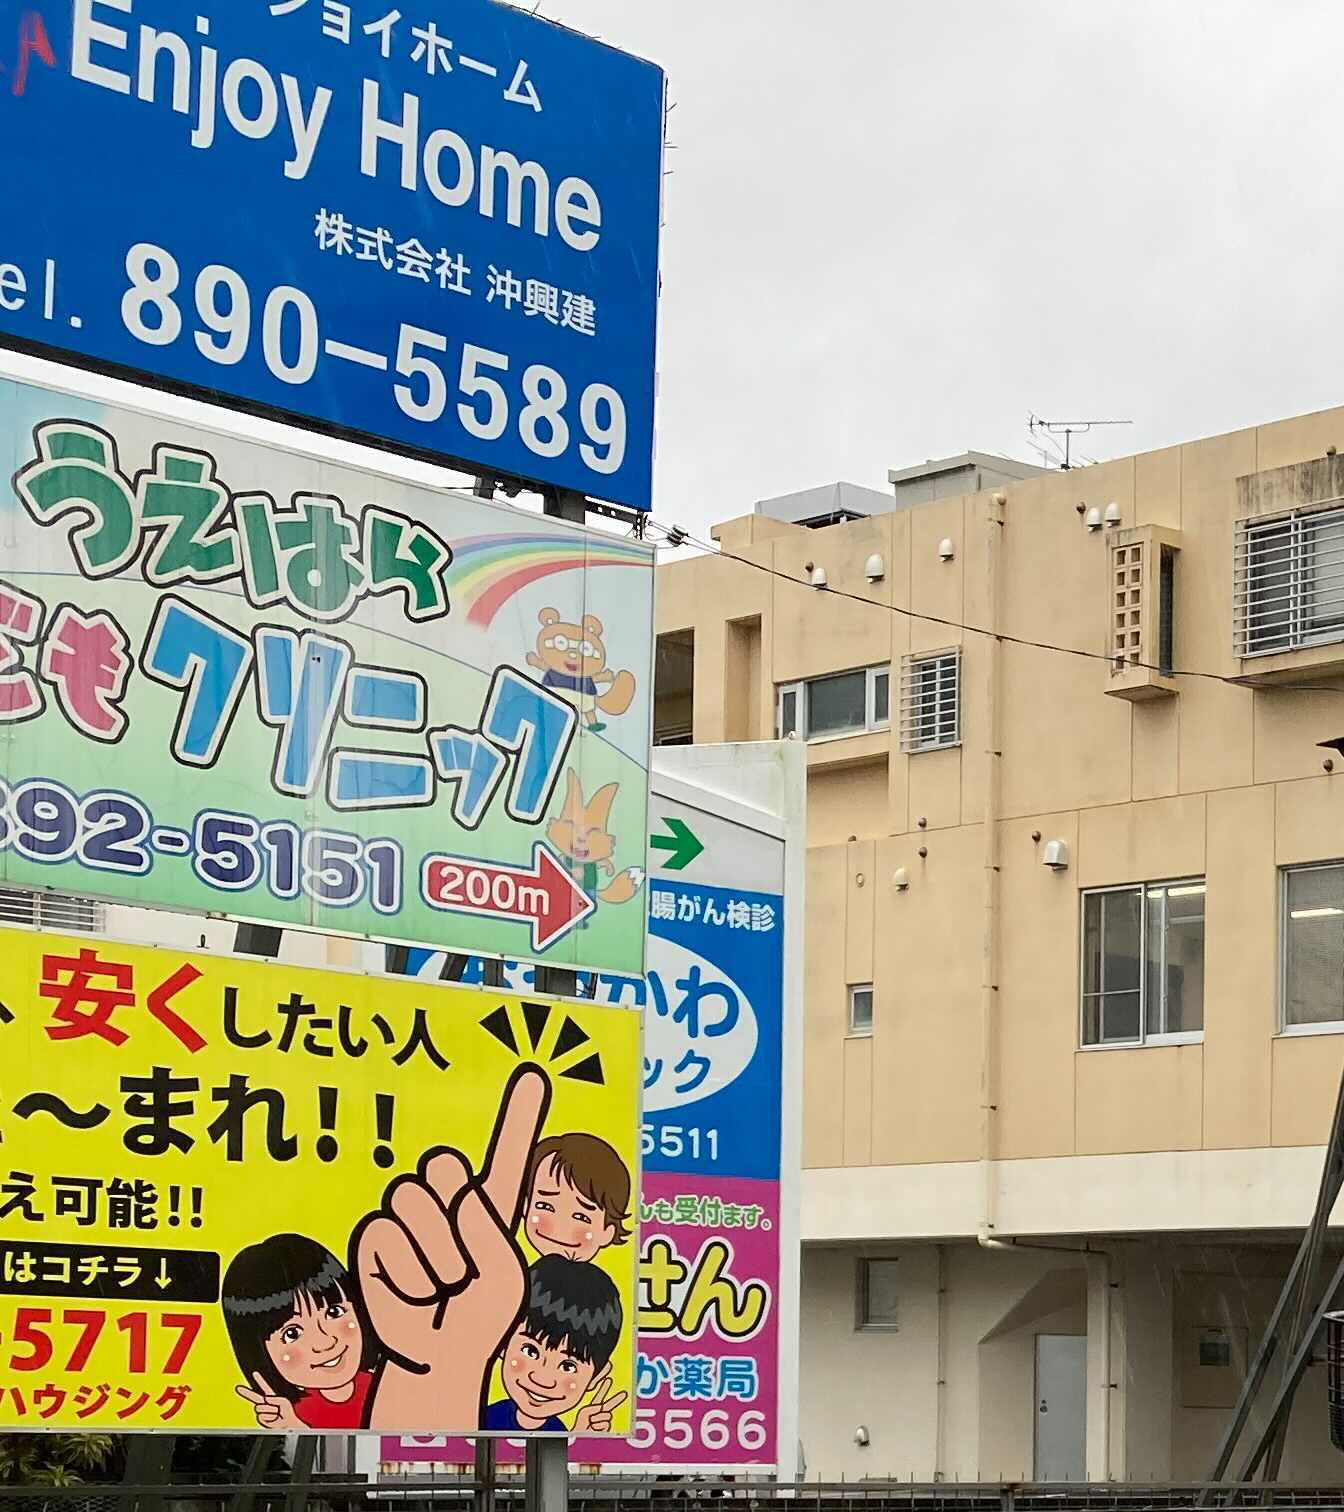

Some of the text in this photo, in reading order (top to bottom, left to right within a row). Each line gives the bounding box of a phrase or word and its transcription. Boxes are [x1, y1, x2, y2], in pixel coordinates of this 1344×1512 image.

[70, 0, 602, 252] Enjoy Home
[314, 208, 597, 337] 株式会社 沖興建
[120, 243, 628, 474] 890-5589
[0, 780, 402, 915] 92-5151
[438, 865, 551, 917] 200m
[648, 890, 776, 932] 腸がん検診
[0, 948, 451, 1072] 安くしたい人
[0, 1383, 192, 1422] ハウジング
[625, 1408, 767, 1450] 5566
